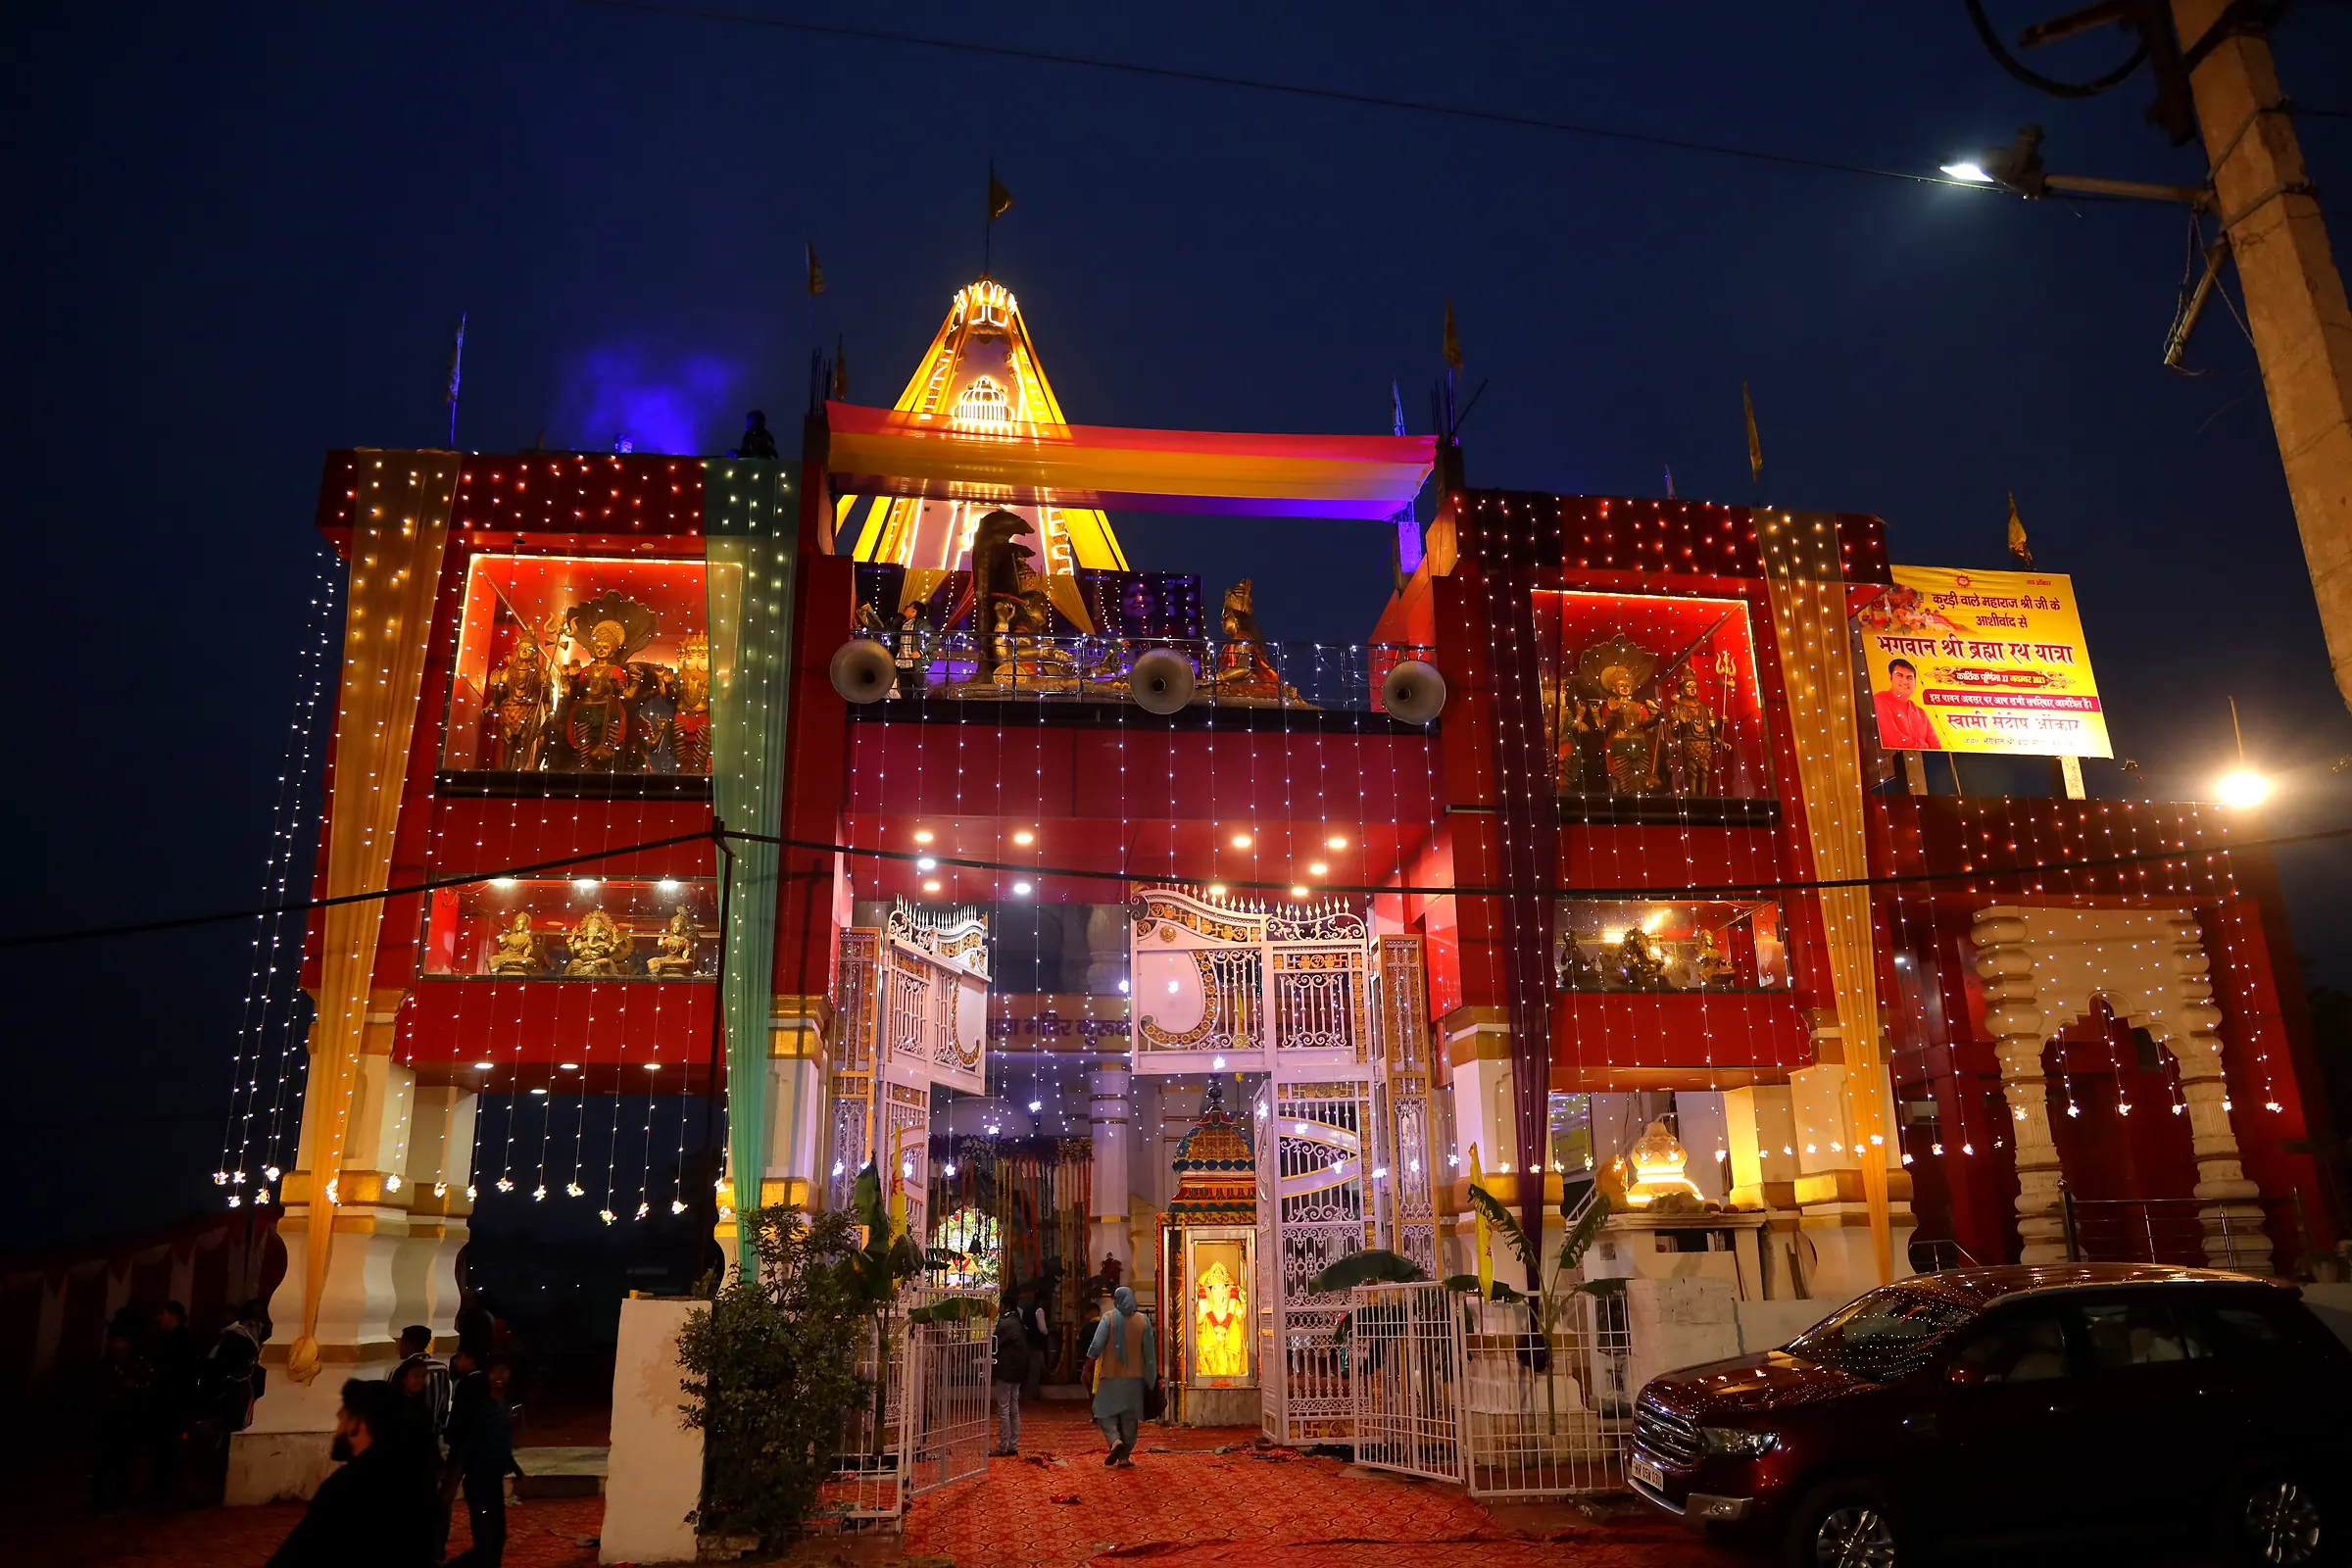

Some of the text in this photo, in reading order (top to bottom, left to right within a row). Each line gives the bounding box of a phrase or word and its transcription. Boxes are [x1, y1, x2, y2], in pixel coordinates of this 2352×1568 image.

[1959, 593, 1980, 607] वाले
[1982, 597, 2018, 609] महाराज
[2021, 595, 2033, 610] श्री
[2034, 596, 2048, 611] जी
[2049, 598, 2060, 611] के
[1976, 612, 2028, 628] आशीर्वाद से
[1877, 633, 2074, 663] भगवान श्री ब्रह्मा रथ यात्रा
[1956, 671, 1980, 680] कार्तिक
[1930, 694, 1940, 704] इस
[1941, 694, 1960, 703] पावन
[1961, 695, 1984, 706] अवसर
[1984, 697, 1993, 706] पर
[2009, 695, 2025, 706] सभी
[1946, 710, 1987, 729] स्वामी
